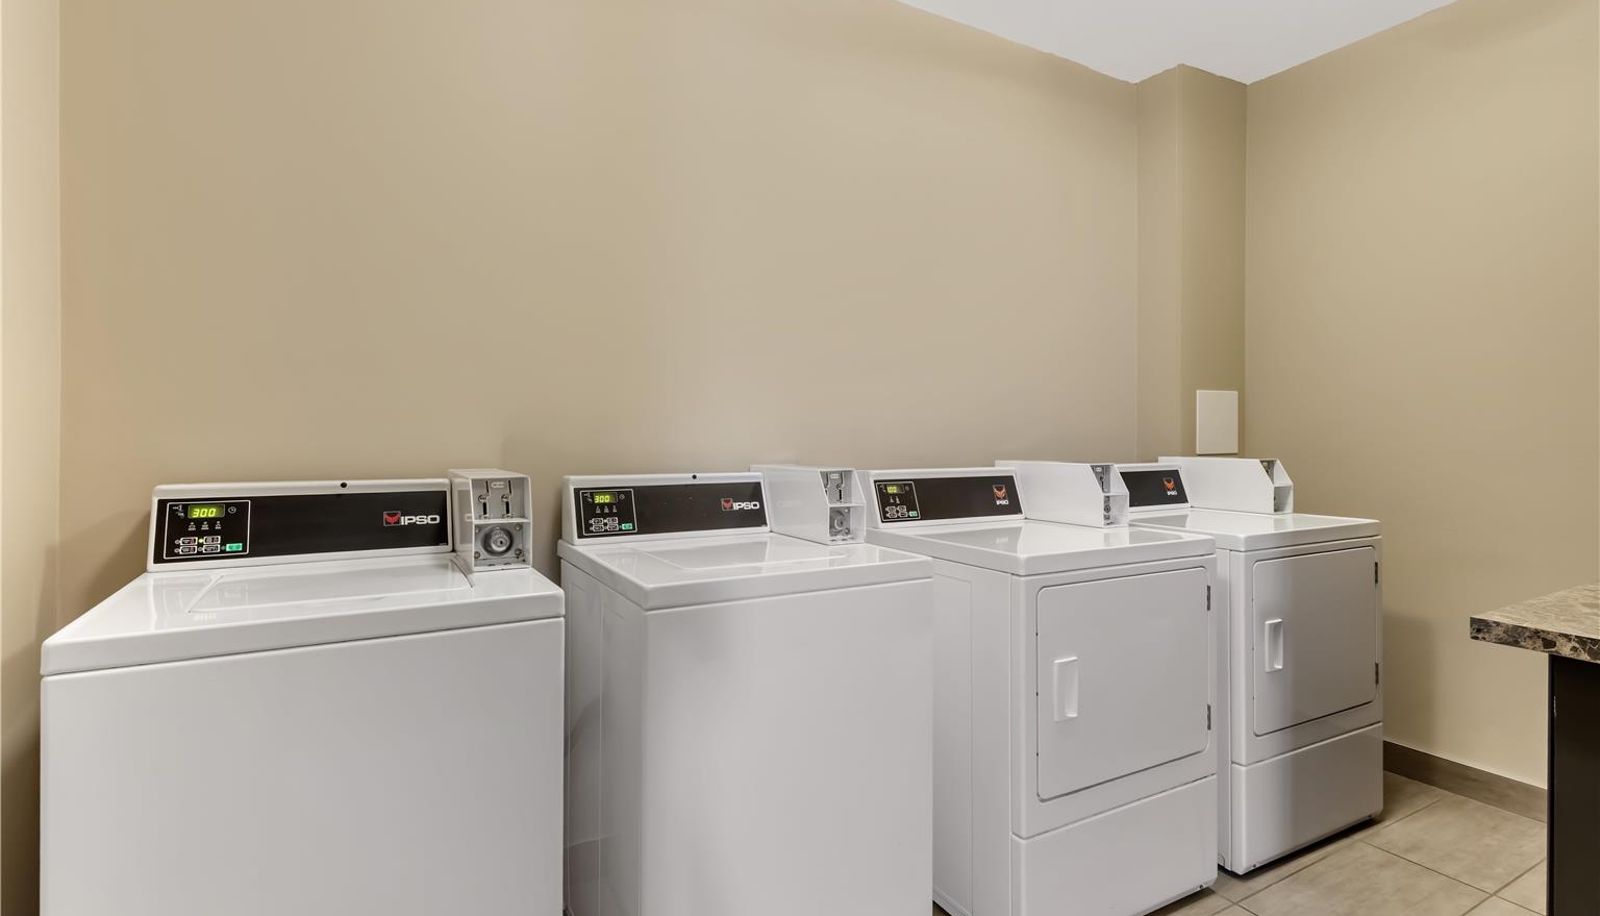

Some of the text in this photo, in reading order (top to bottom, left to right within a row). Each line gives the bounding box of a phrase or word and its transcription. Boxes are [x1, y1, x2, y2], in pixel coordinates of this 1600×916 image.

[594, 495, 610, 504] 300
[733, 501, 760, 510] IPSO
[192, 507, 217, 518] 300
[400, 514, 440, 526] IPSO
